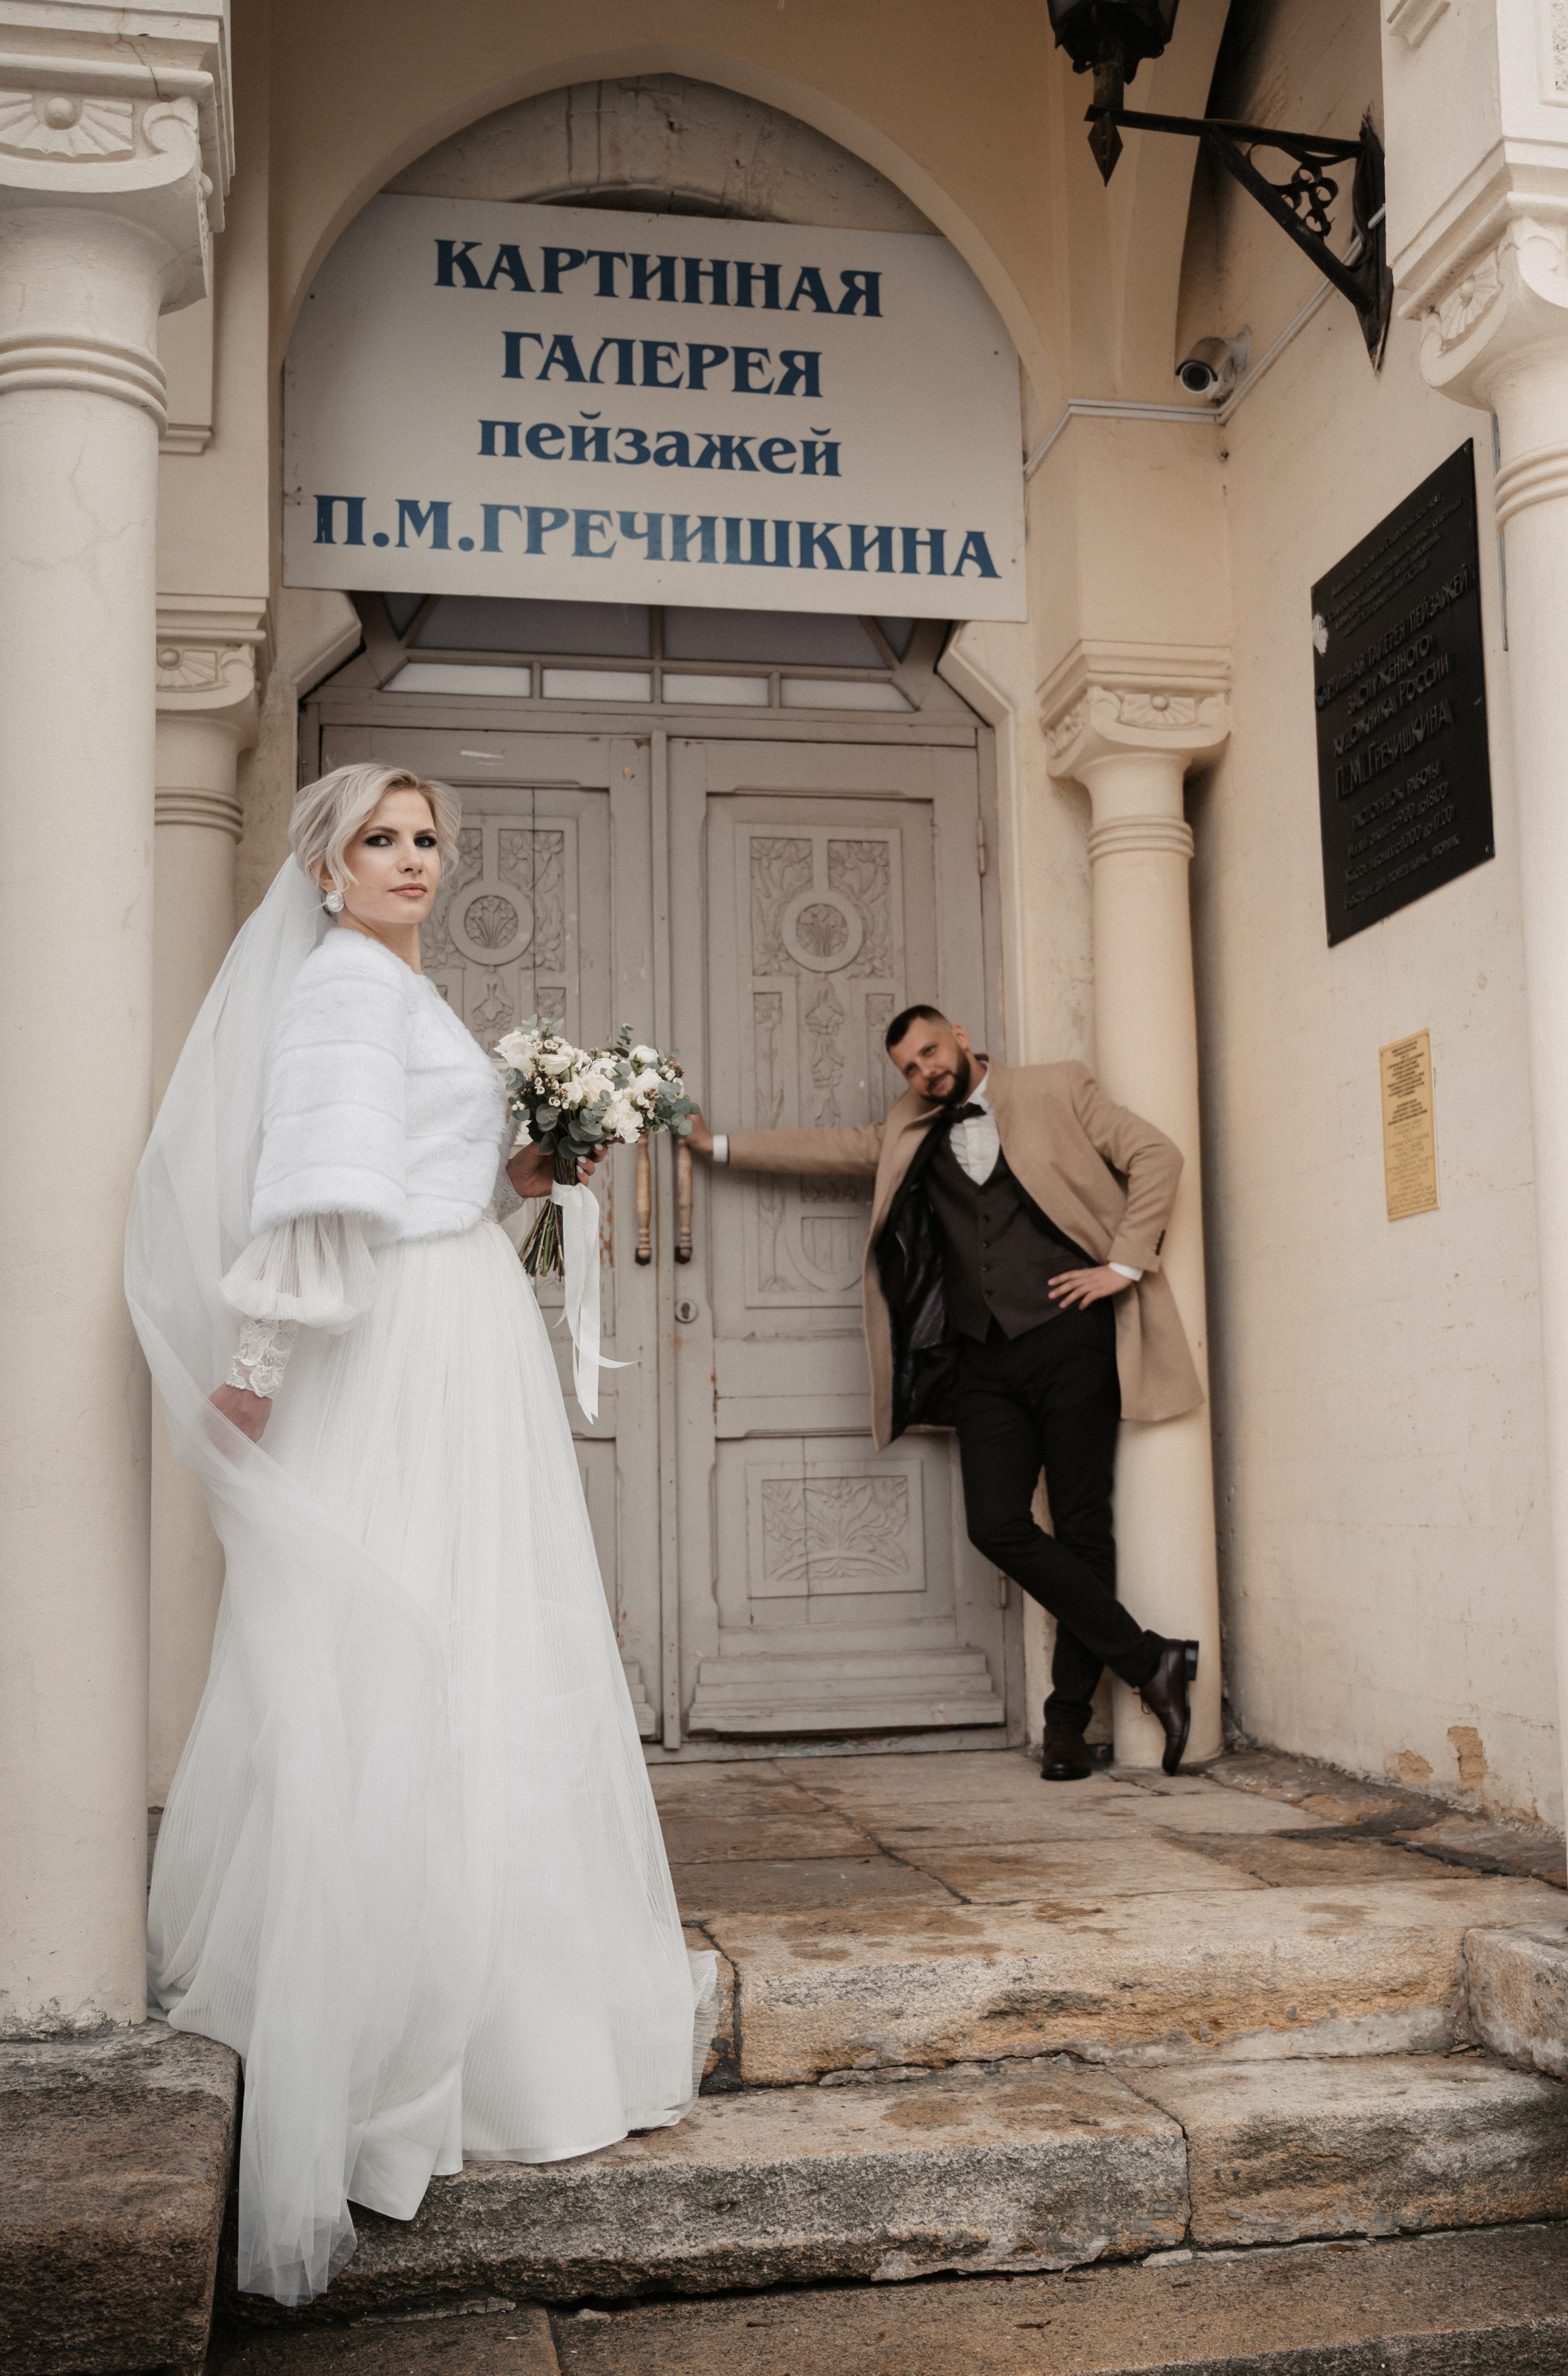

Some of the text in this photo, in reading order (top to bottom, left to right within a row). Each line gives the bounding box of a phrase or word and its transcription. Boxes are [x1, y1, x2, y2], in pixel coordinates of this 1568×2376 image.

[434, 239, 884, 318] КАРТИННАЯ
[502, 331, 823, 398] ГАЛЕРЕЯ
[477, 411, 842, 477] пейзажей
[313, 495, 1003, 579] П.М.ГРЕЧИШКИНА
